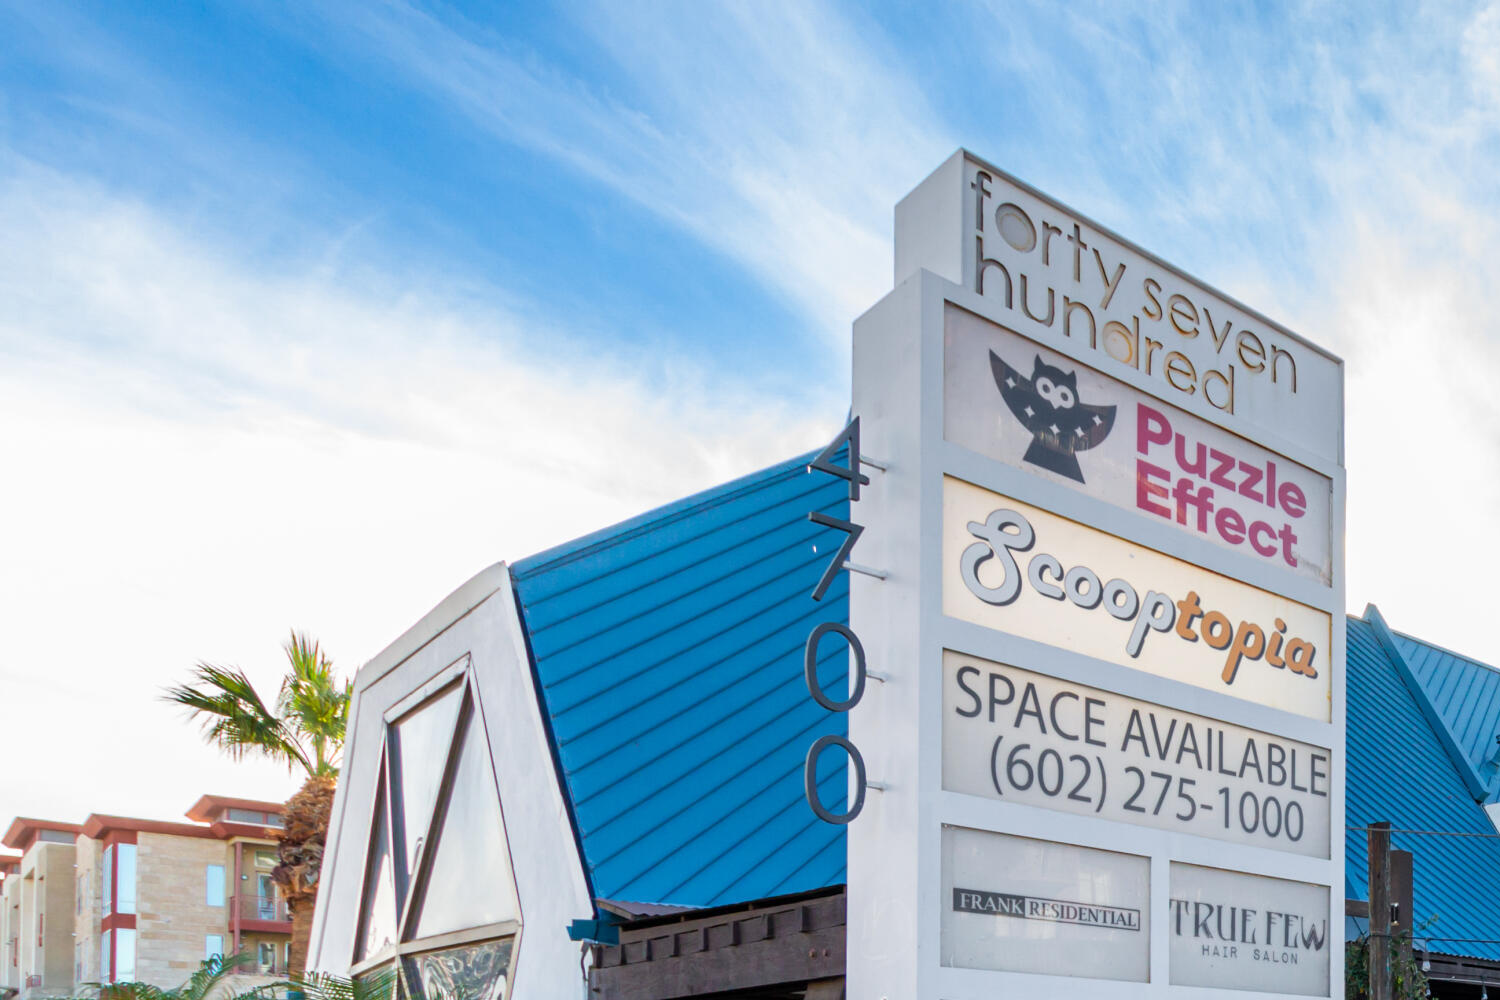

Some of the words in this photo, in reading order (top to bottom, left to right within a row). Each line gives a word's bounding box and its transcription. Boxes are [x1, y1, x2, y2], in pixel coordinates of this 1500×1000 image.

[970, 170, 1126, 310] forty
[1143, 278, 1297, 394] seven
[976, 235, 1235, 415] hundred
[1136, 402, 1308, 518] Puzzle
[1136, 458, 1298, 568] Effect
[960, 508, 1318, 684] Scooptopia
[955, 665, 1107, 748] SPACE
[1120, 709, 1328, 798] AVAILABLE
[990, 735, 1107, 813] (602)
[1123, 766, 1305, 842] 275-1000
[1169, 899, 1257, 945] TRUE
[1266, 911, 1326, 951] FEW
[1202, 944, 1238, 959] HAIR
[1253, 949, 1299, 965] SALON
